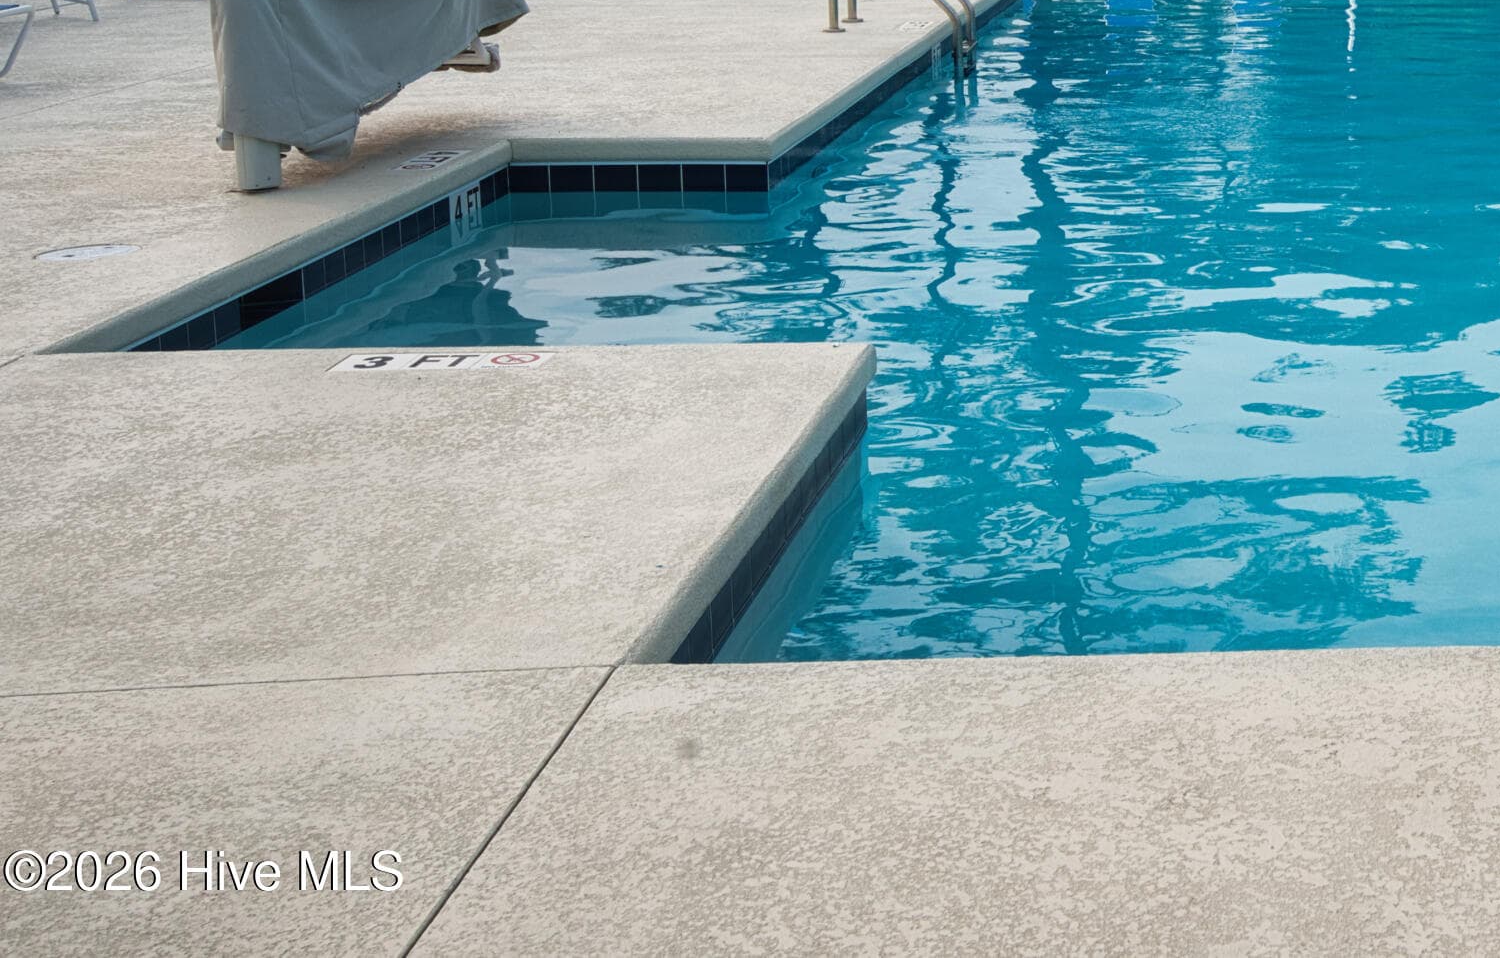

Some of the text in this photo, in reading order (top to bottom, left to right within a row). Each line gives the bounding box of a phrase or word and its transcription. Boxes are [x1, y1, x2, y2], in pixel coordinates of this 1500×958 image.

[454, 186, 480, 220] 4 FT
[352, 354, 481, 369] 3 FT
